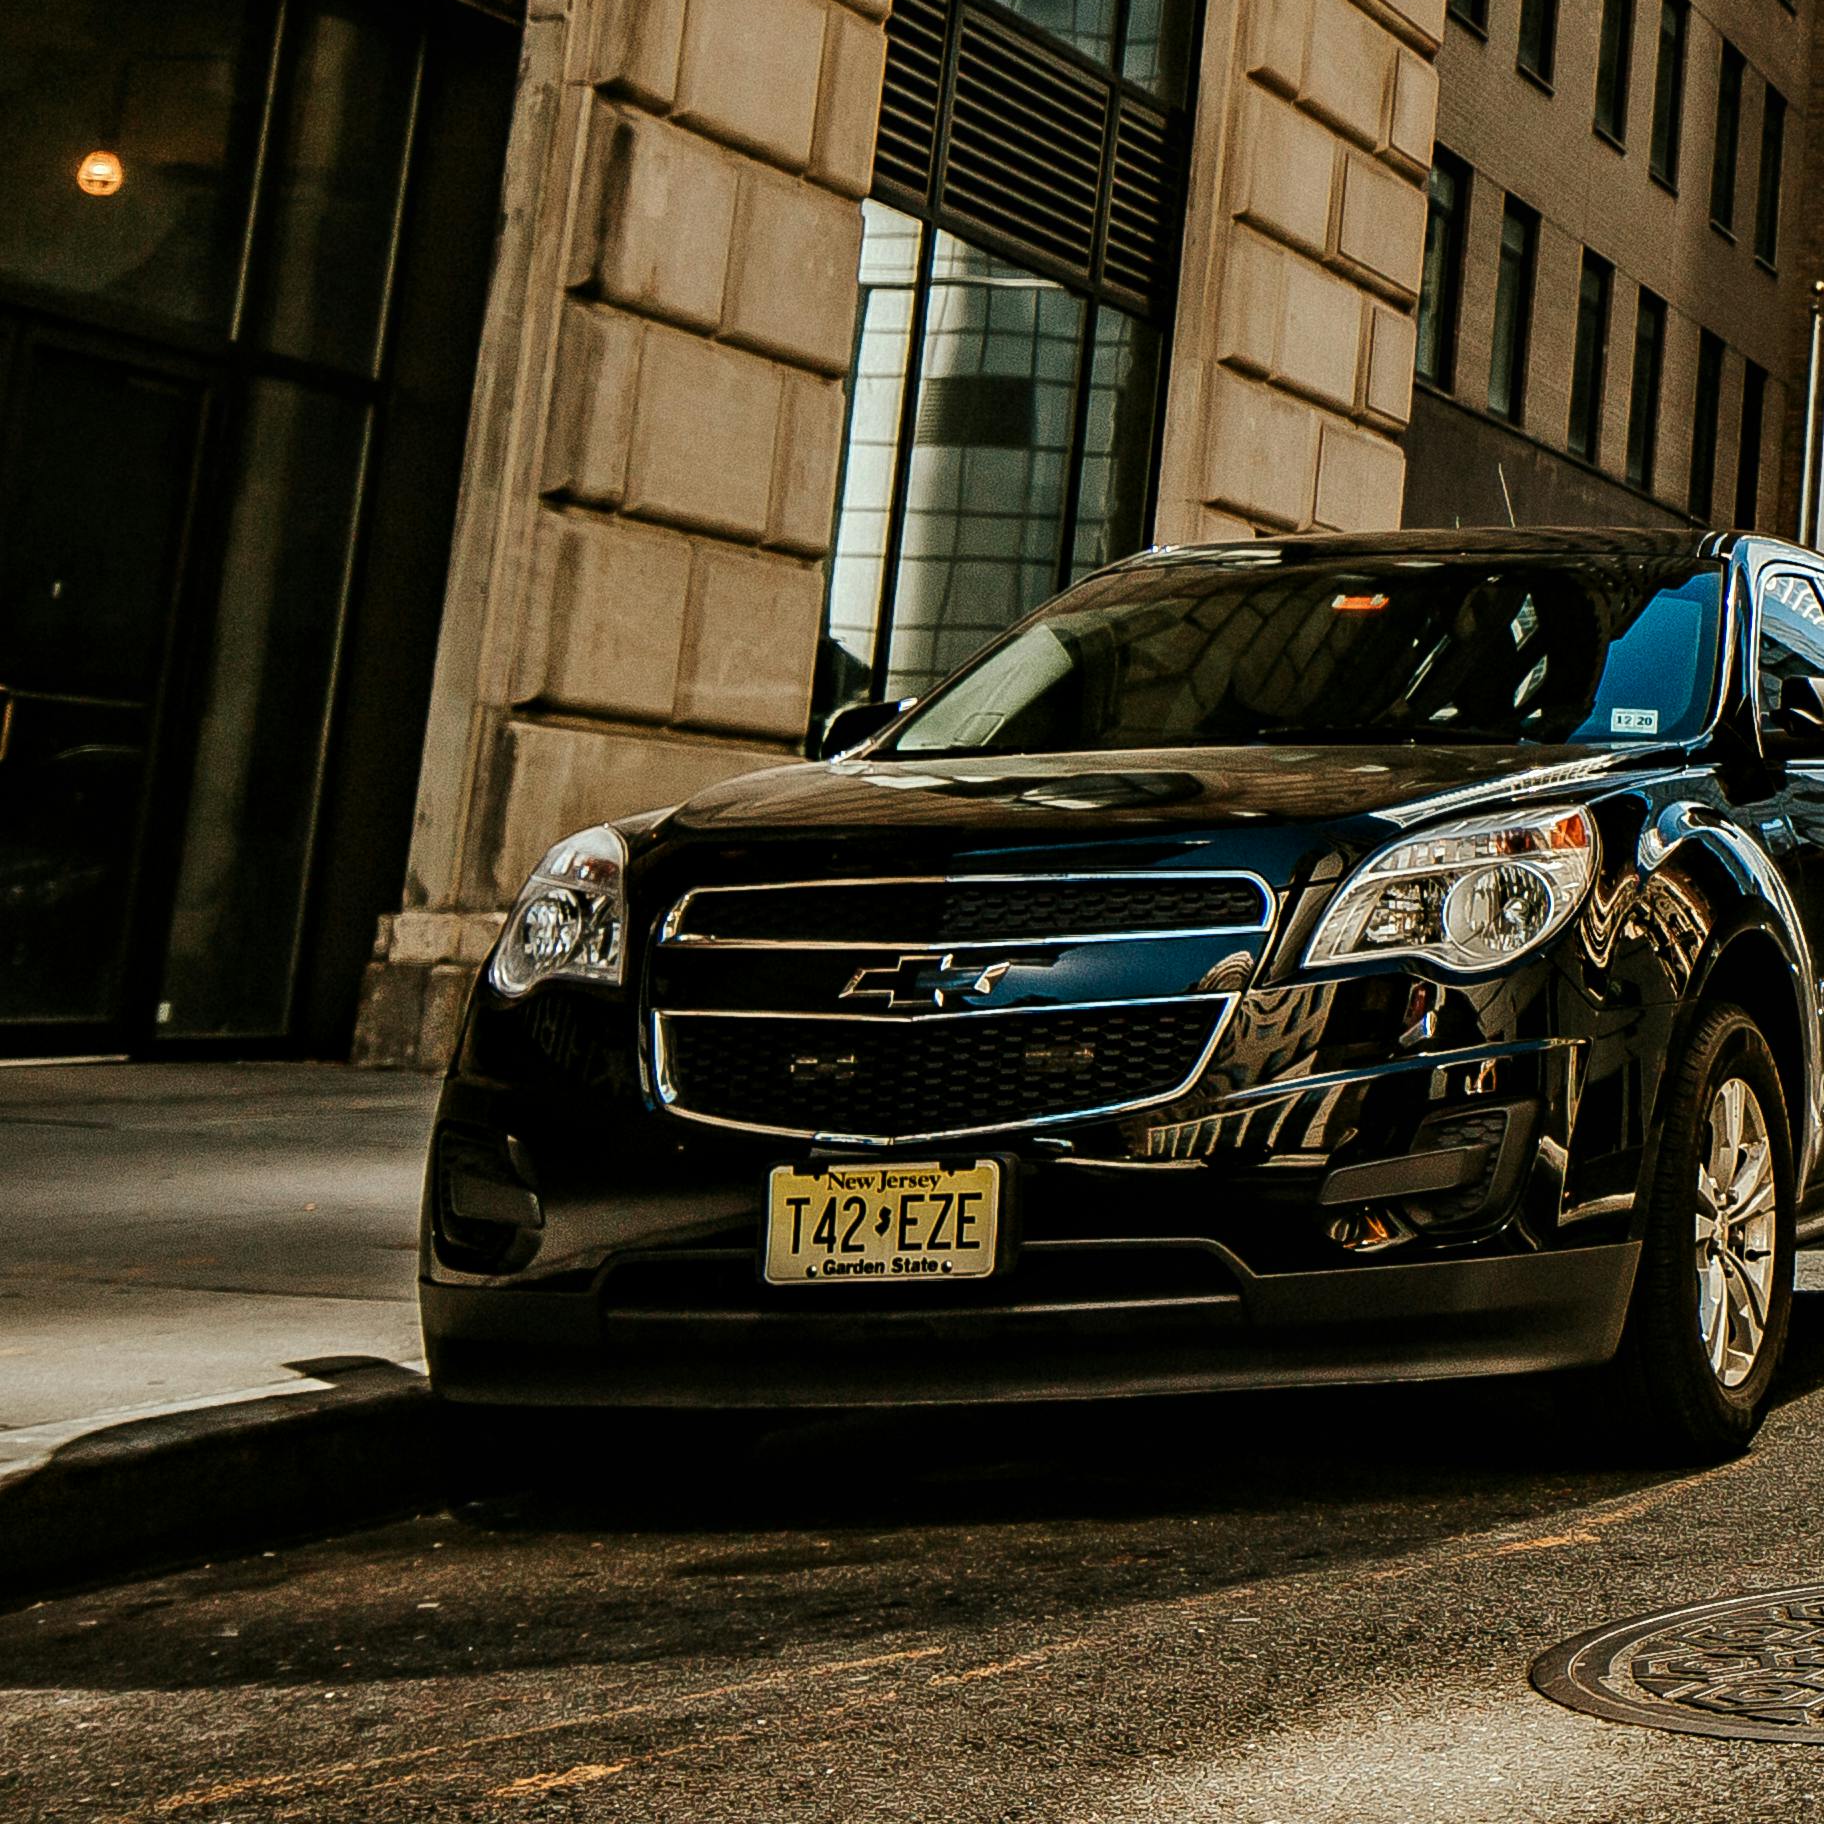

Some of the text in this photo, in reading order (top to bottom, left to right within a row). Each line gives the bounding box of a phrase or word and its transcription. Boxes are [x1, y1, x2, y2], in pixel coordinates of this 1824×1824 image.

[827, 1170, 942, 1193] New Jersey
[897, 1192, 983, 1252] EZE
[822, 1257, 939, 1276] Garden State
